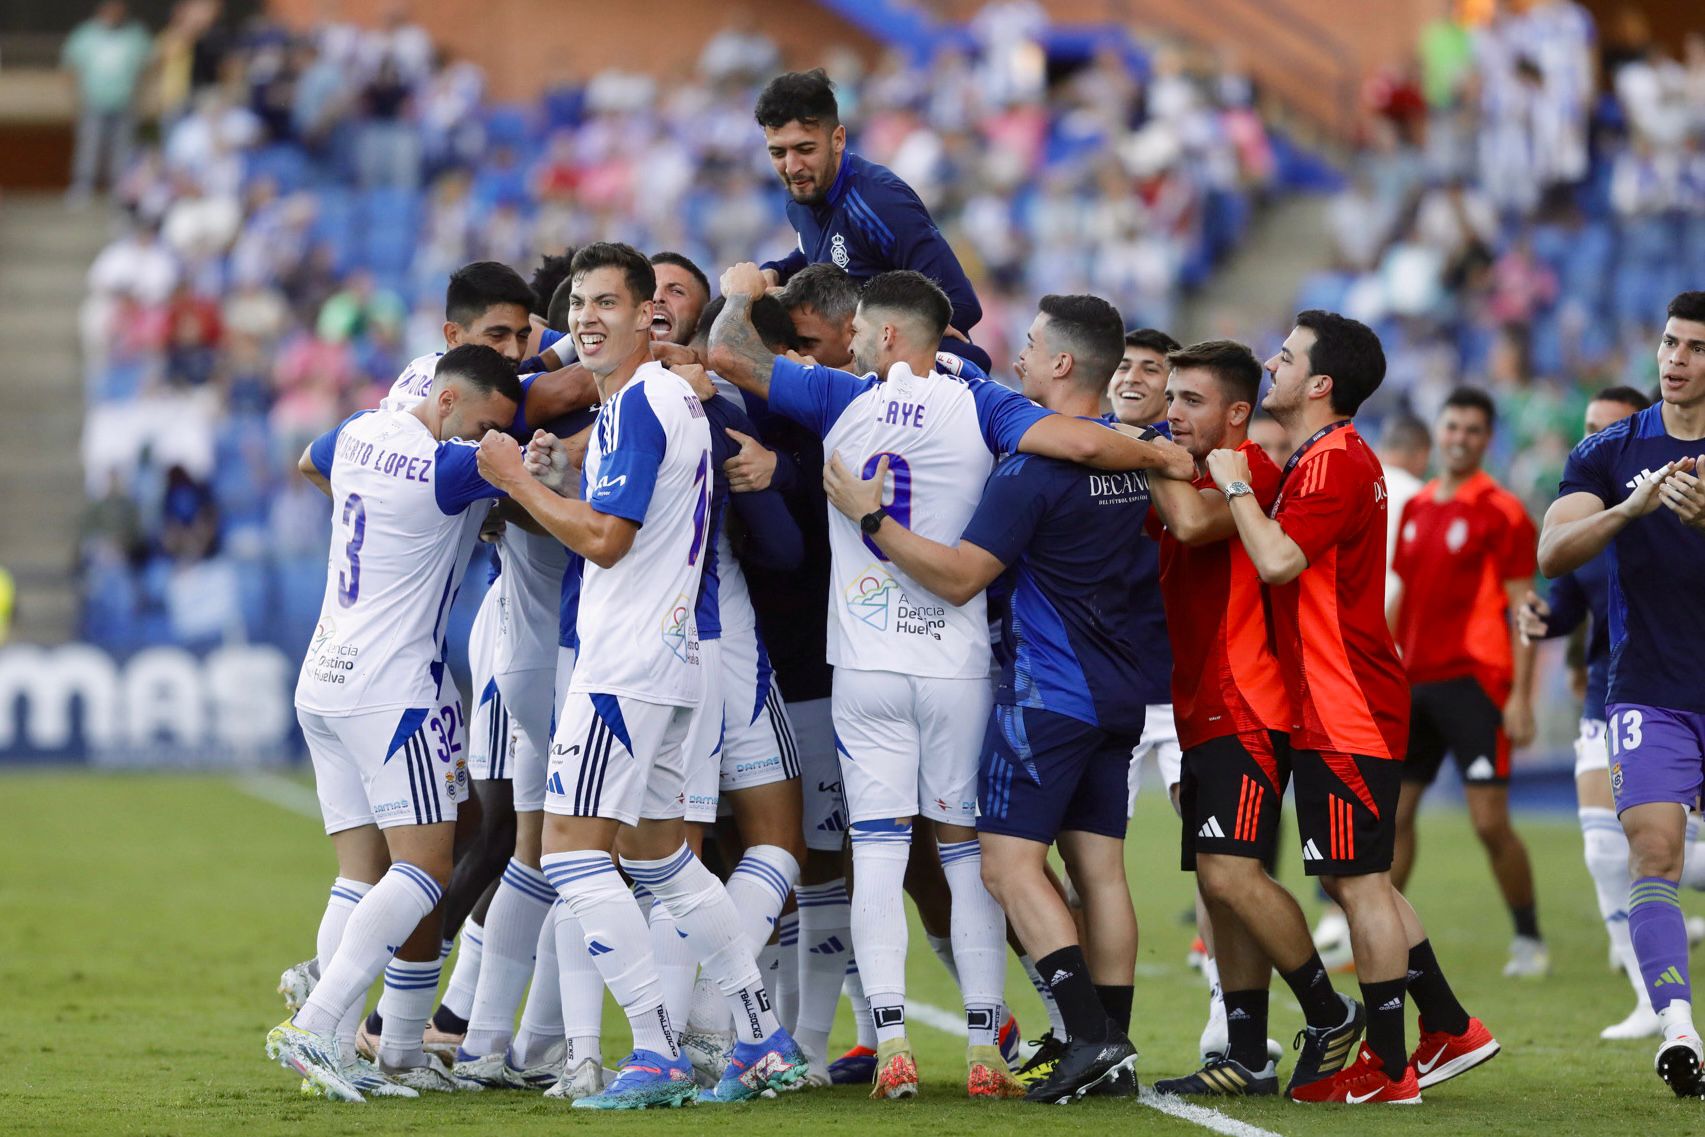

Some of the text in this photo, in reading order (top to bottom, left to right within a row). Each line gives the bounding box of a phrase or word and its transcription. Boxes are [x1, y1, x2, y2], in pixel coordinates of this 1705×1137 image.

[374, 449, 433, 483] LOPEZ
[338, 493, 366, 609] 3
[1609, 709, 1643, 757] 13
